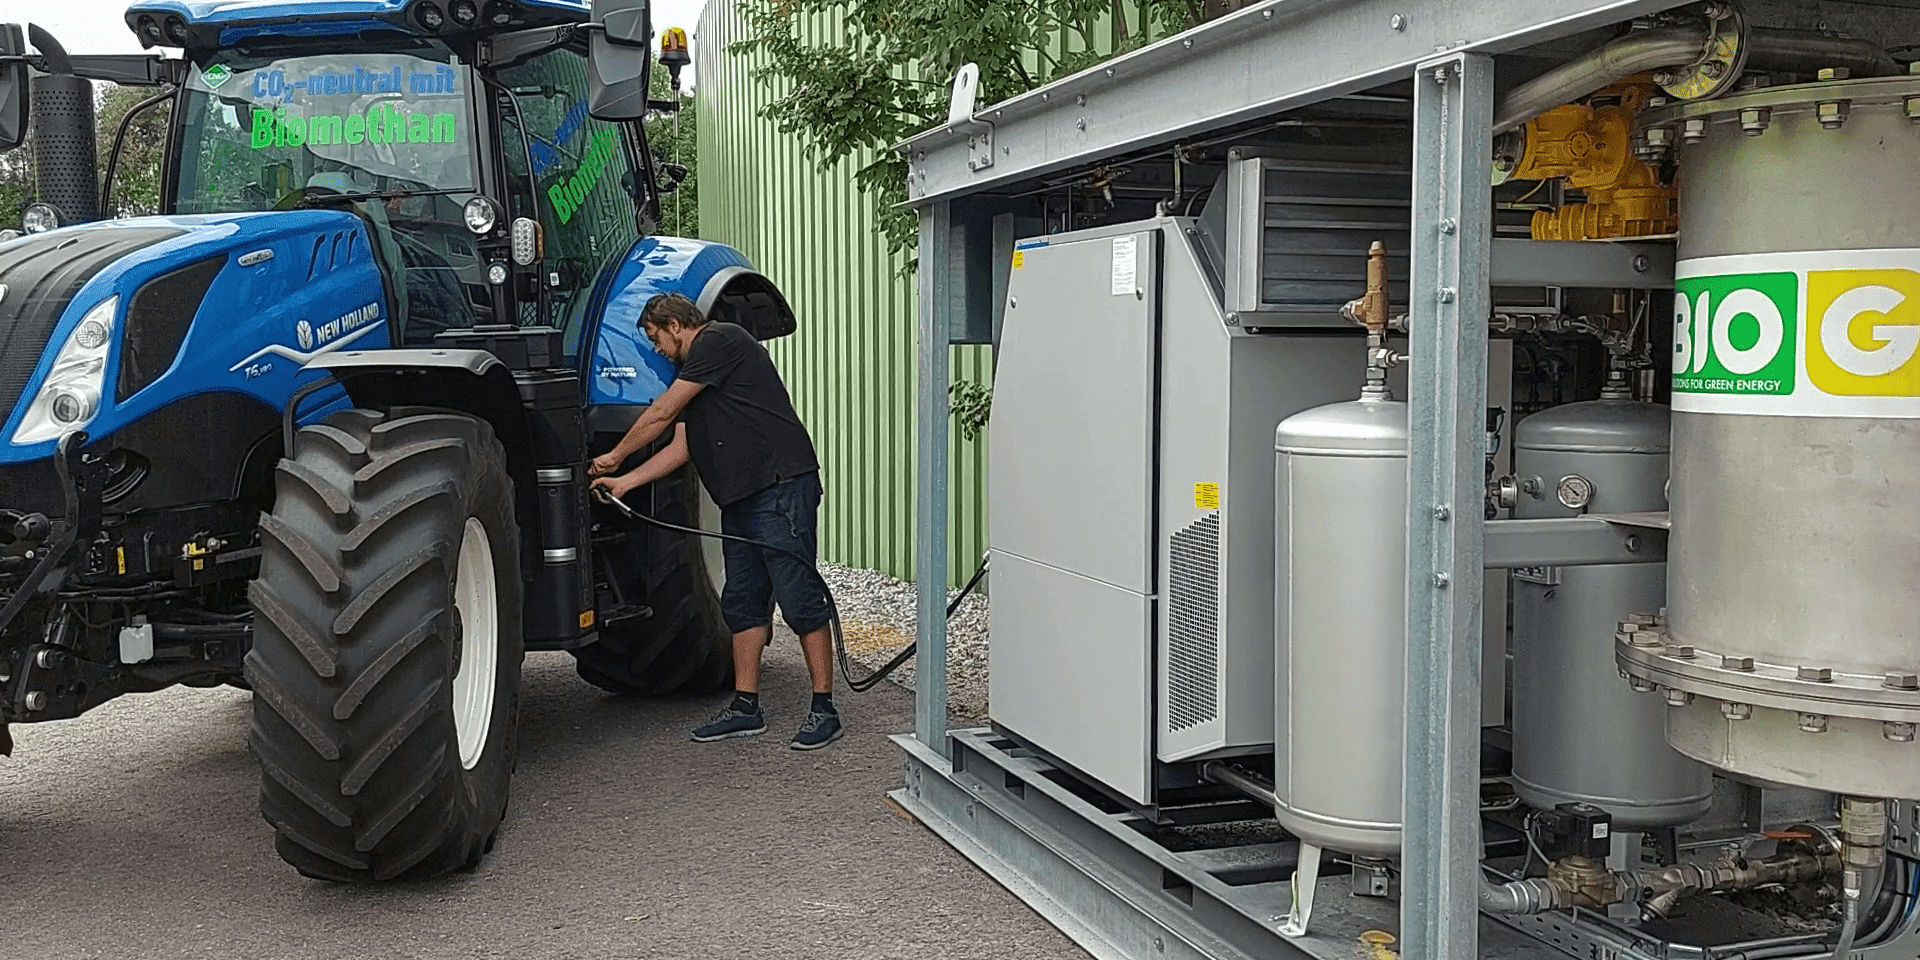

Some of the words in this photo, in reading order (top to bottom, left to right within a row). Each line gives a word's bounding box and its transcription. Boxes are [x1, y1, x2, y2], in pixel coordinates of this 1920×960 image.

[409, 66, 454, 93] mit
[251, 102, 455, 149] Biomethan
[316, 319, 340, 345] NEW
[341, 302, 379, 332] HOLLAND
[1690, 379, 1703, 389] FOR
[1704, 379, 1733, 389] GREEN
[1736, 379, 1781, 391] ENERGY
